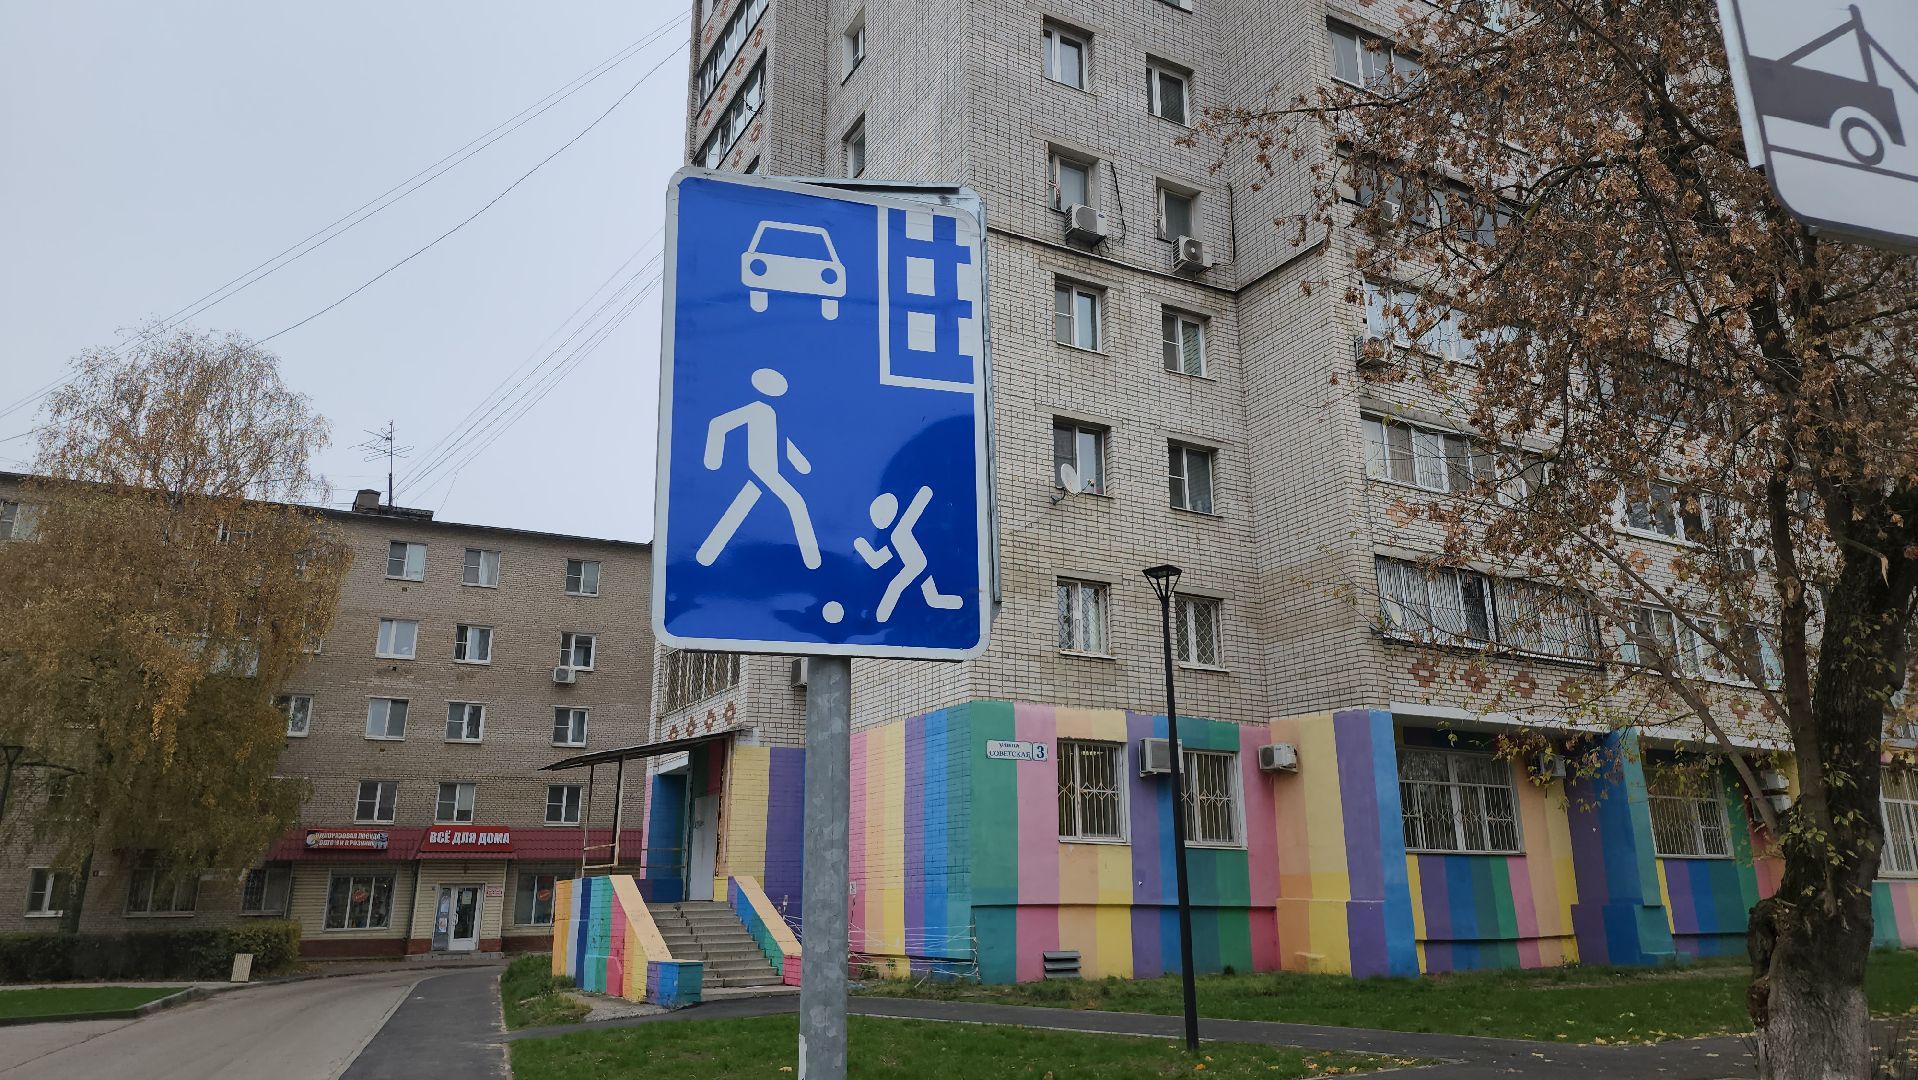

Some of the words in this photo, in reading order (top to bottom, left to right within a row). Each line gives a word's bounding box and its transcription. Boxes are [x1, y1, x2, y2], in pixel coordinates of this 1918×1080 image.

[989, 750, 1031, 759] СОВЕТСКАЯ
[1036, 745, 1045, 759] 3
[429, 830, 451, 844] ВСЁ
[452, 832, 477, 845] ДЛЯ
[478, 832, 510, 845] ДОМА
